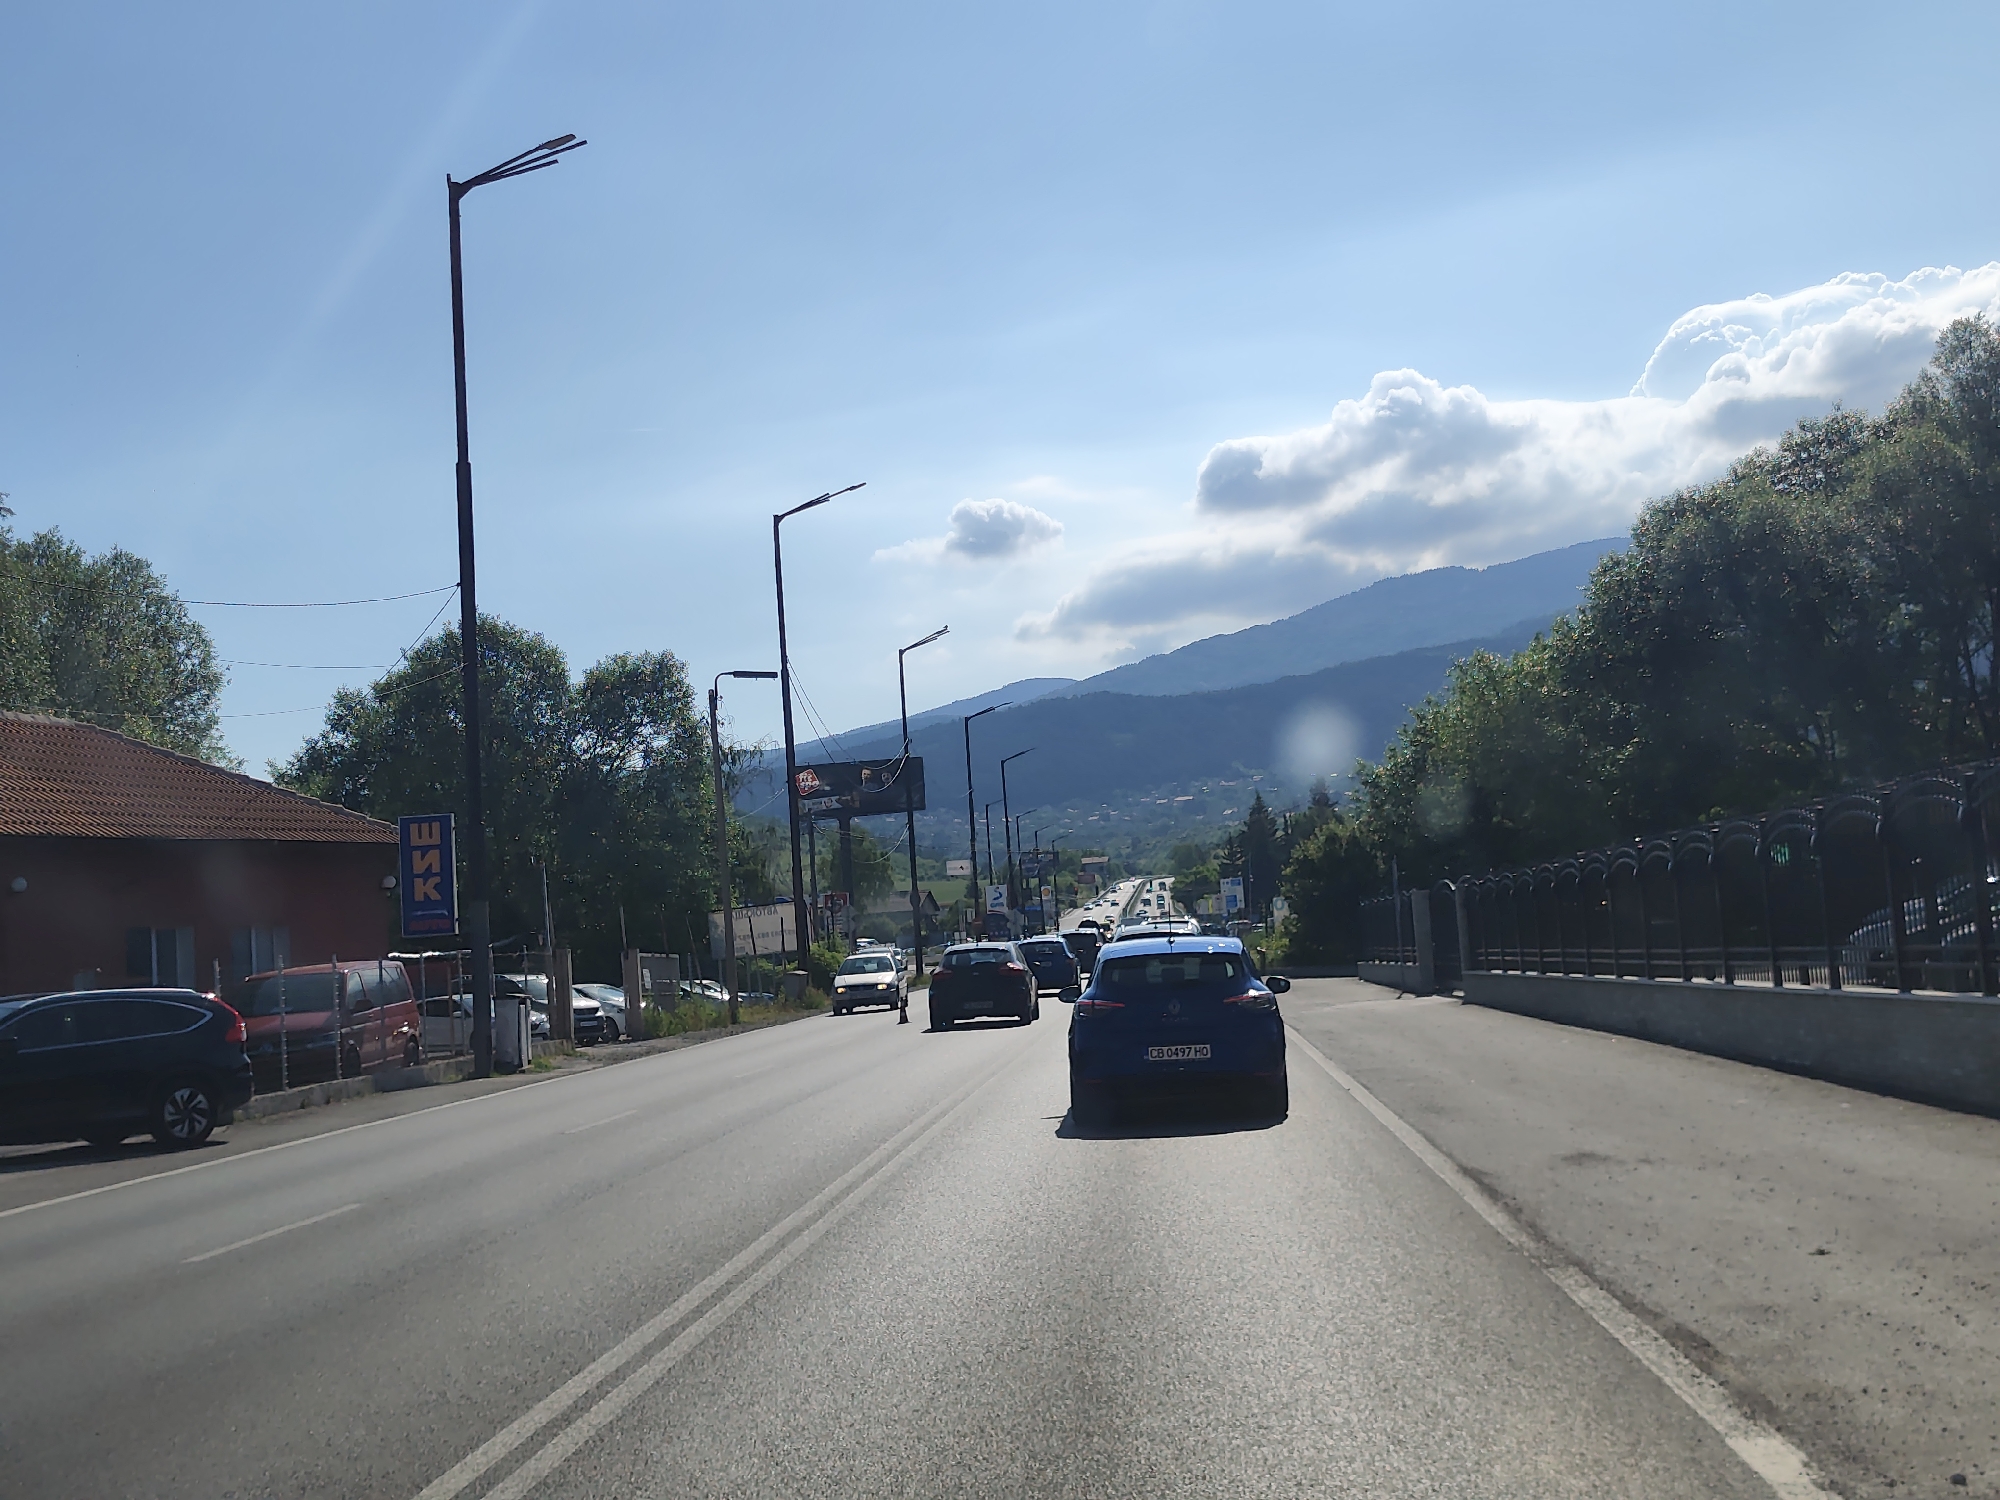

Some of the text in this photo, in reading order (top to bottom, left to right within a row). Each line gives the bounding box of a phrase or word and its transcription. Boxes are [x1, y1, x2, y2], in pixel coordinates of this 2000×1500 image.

[409, 821, 442, 902] ШИК
[1150, 1048, 1165, 1059] CB
[1166, 1046, 1192, 1058] 0497
